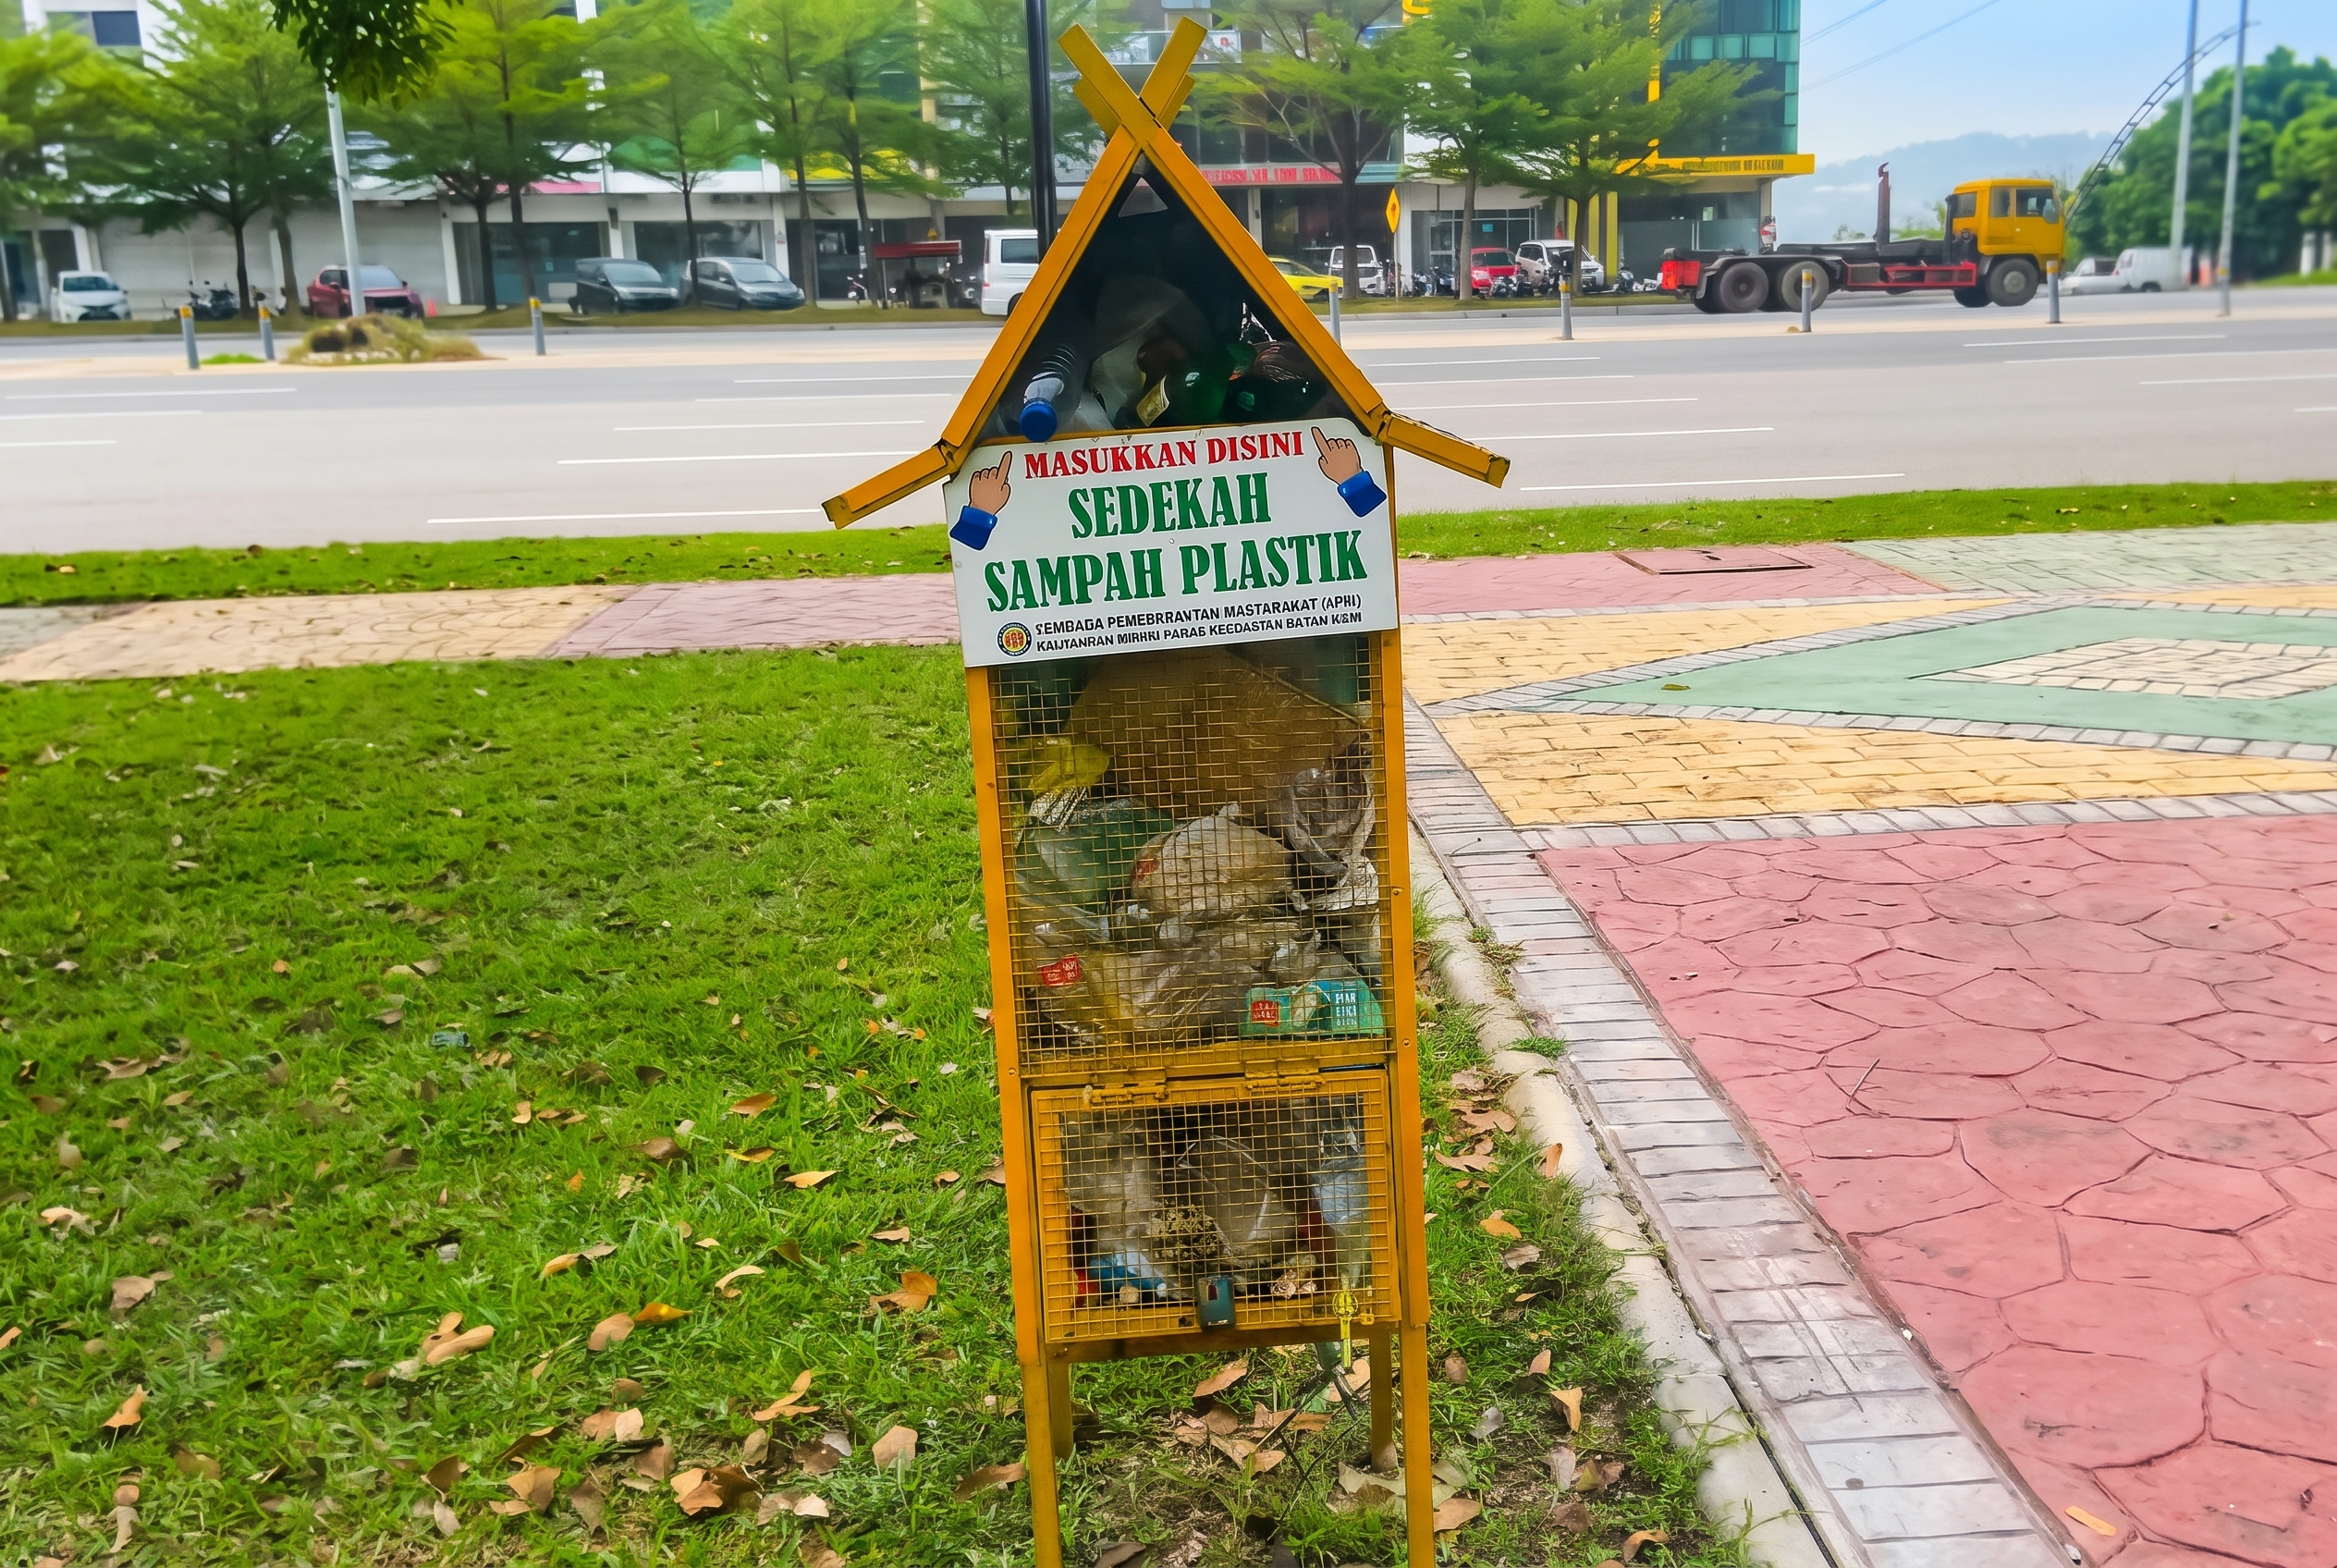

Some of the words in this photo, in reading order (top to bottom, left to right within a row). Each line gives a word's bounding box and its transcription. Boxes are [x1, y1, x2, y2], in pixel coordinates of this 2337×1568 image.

[1024, 439, 1197, 480] MASUKKAN
[1205, 431, 1304, 464] DISINI
[1068, 472, 1272, 539] SEDEKAH
[984, 547, 1167, 613] SAMPAH
[1179, 530, 1368, 595] PLASTIK
[1224, 597, 1318, 619] MASTARAKAT
[1286, 615, 1328, 629] BATAN
